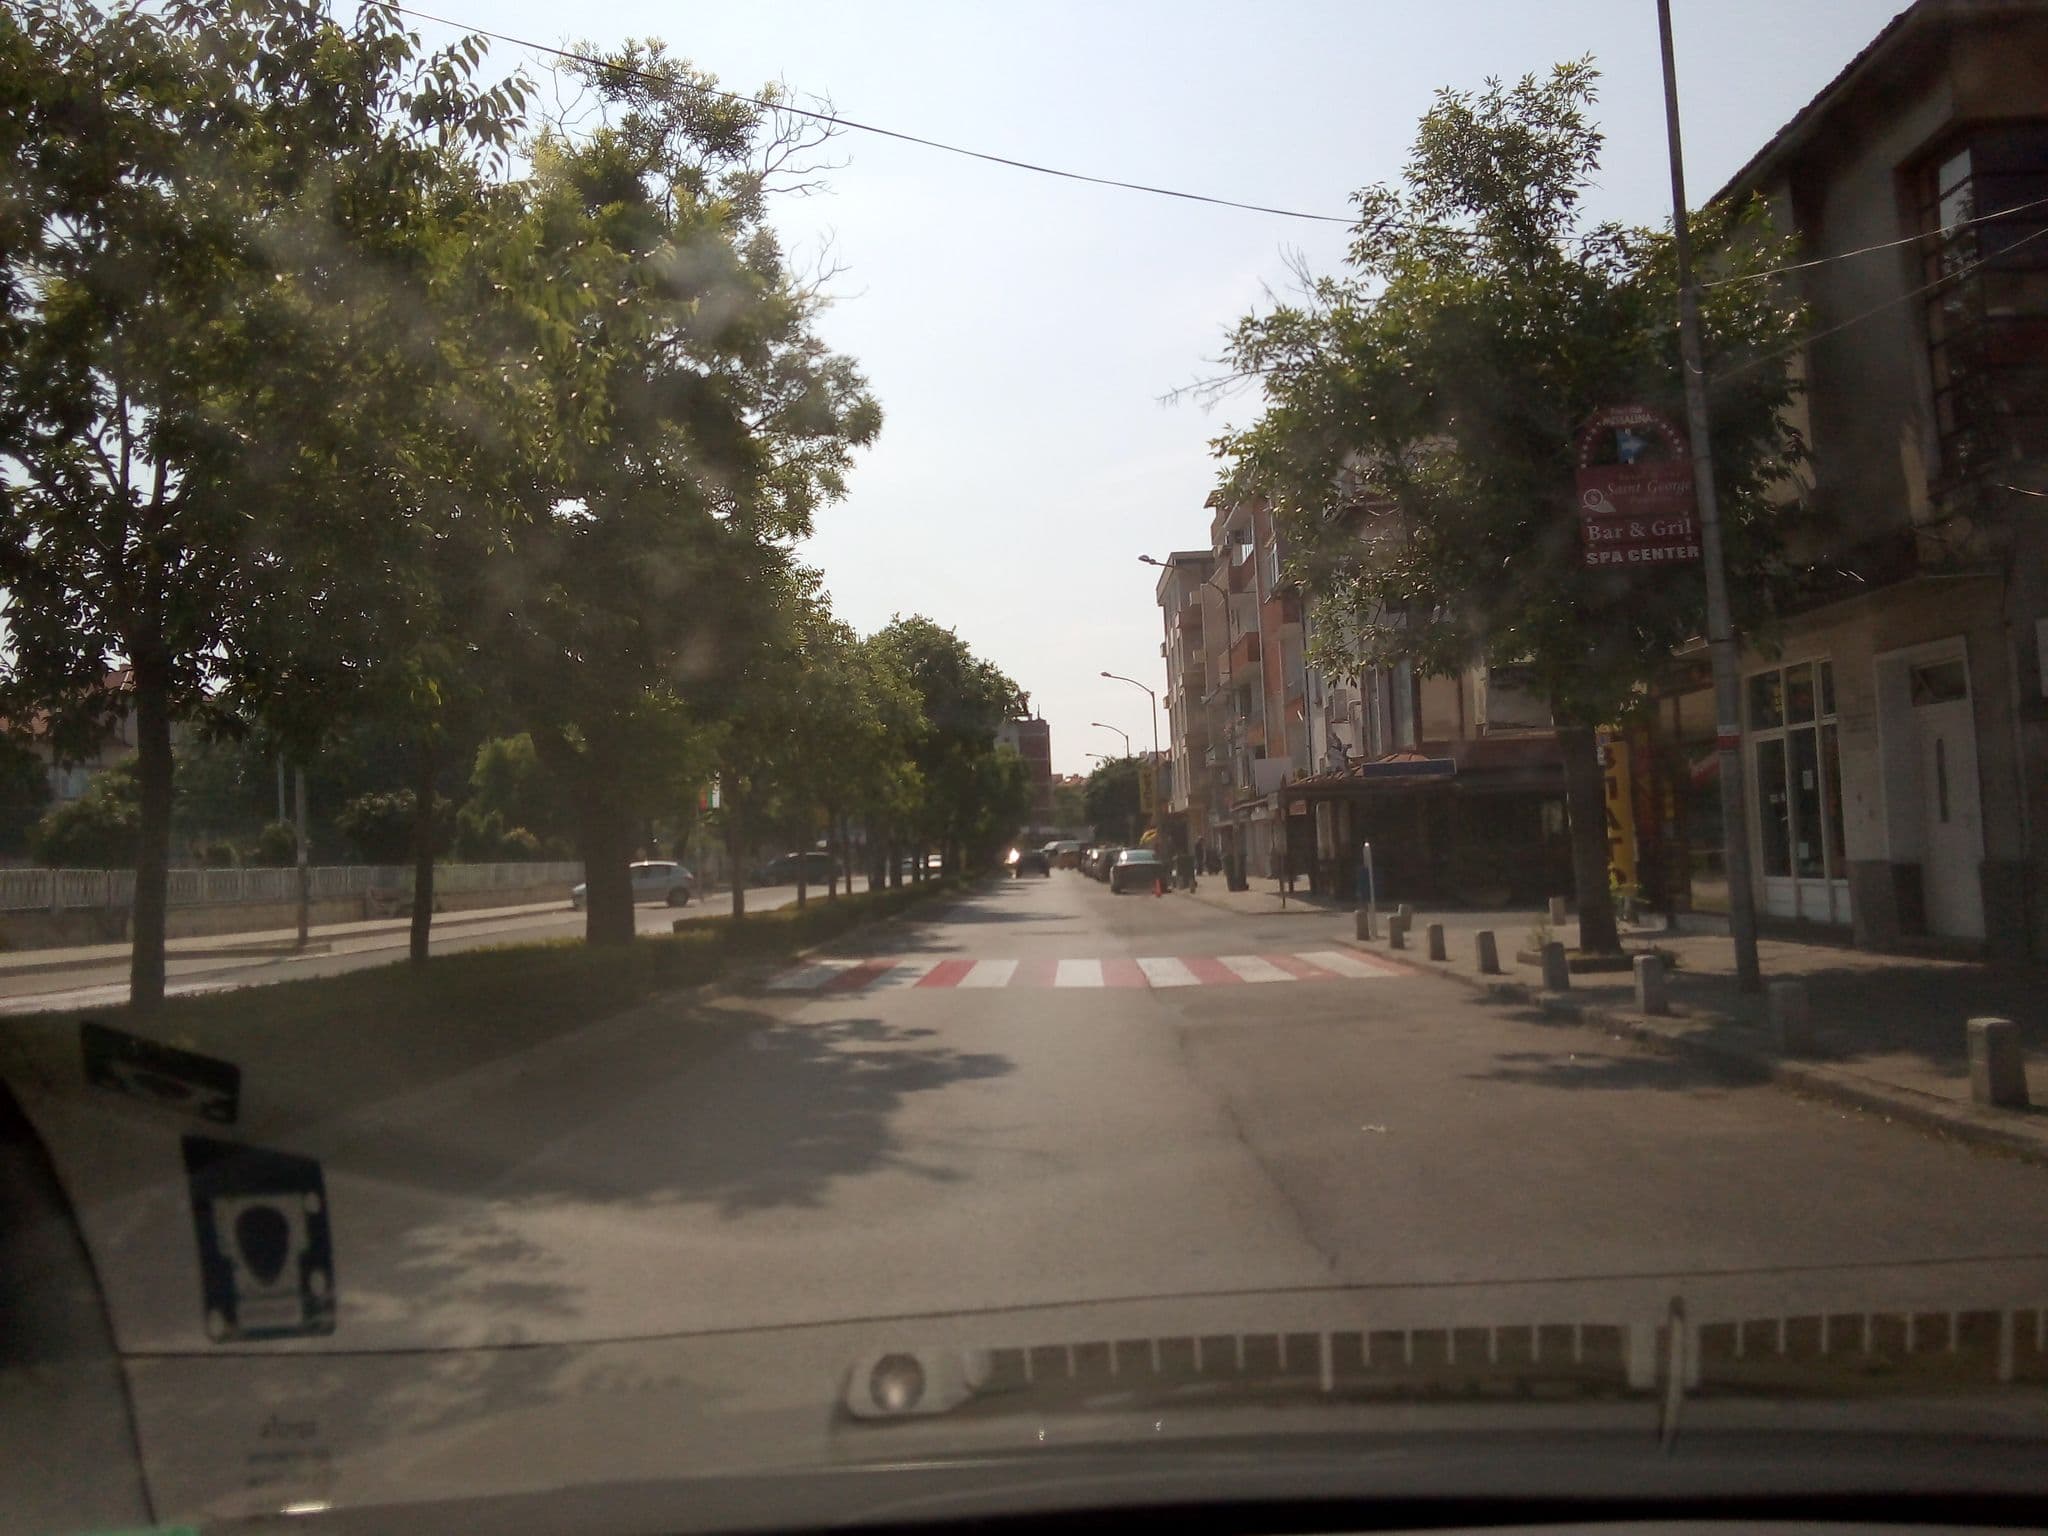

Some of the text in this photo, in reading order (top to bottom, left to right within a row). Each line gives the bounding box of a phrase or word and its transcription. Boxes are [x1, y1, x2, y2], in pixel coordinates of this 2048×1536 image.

[1587, 525, 1623, 541] Bar
[1630, 522, 1646, 537] &
[1586, 546, 1699, 565] SPA CENTER
